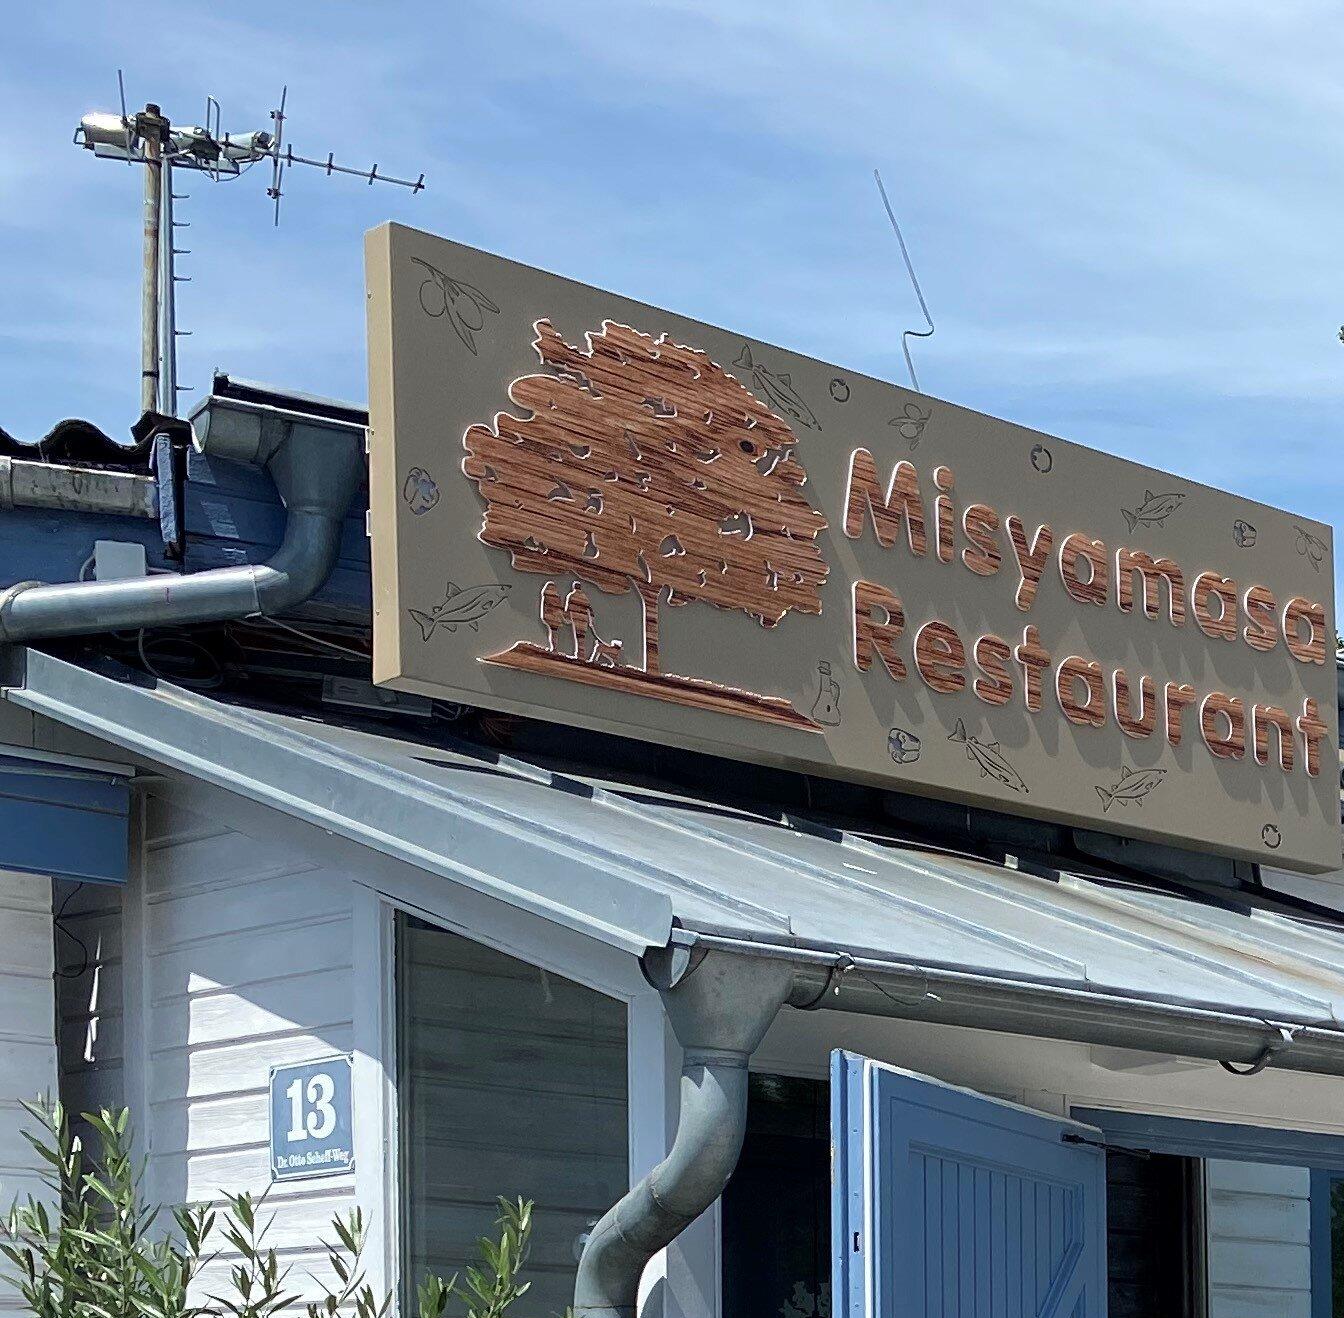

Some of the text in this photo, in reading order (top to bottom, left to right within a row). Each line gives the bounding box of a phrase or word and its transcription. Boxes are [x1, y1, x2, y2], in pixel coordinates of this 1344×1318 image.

[842, 446, 1327, 666] Misyamasa
[851, 579, 1329, 778] Restaurant
[286, 1073, 336, 1141] 13
